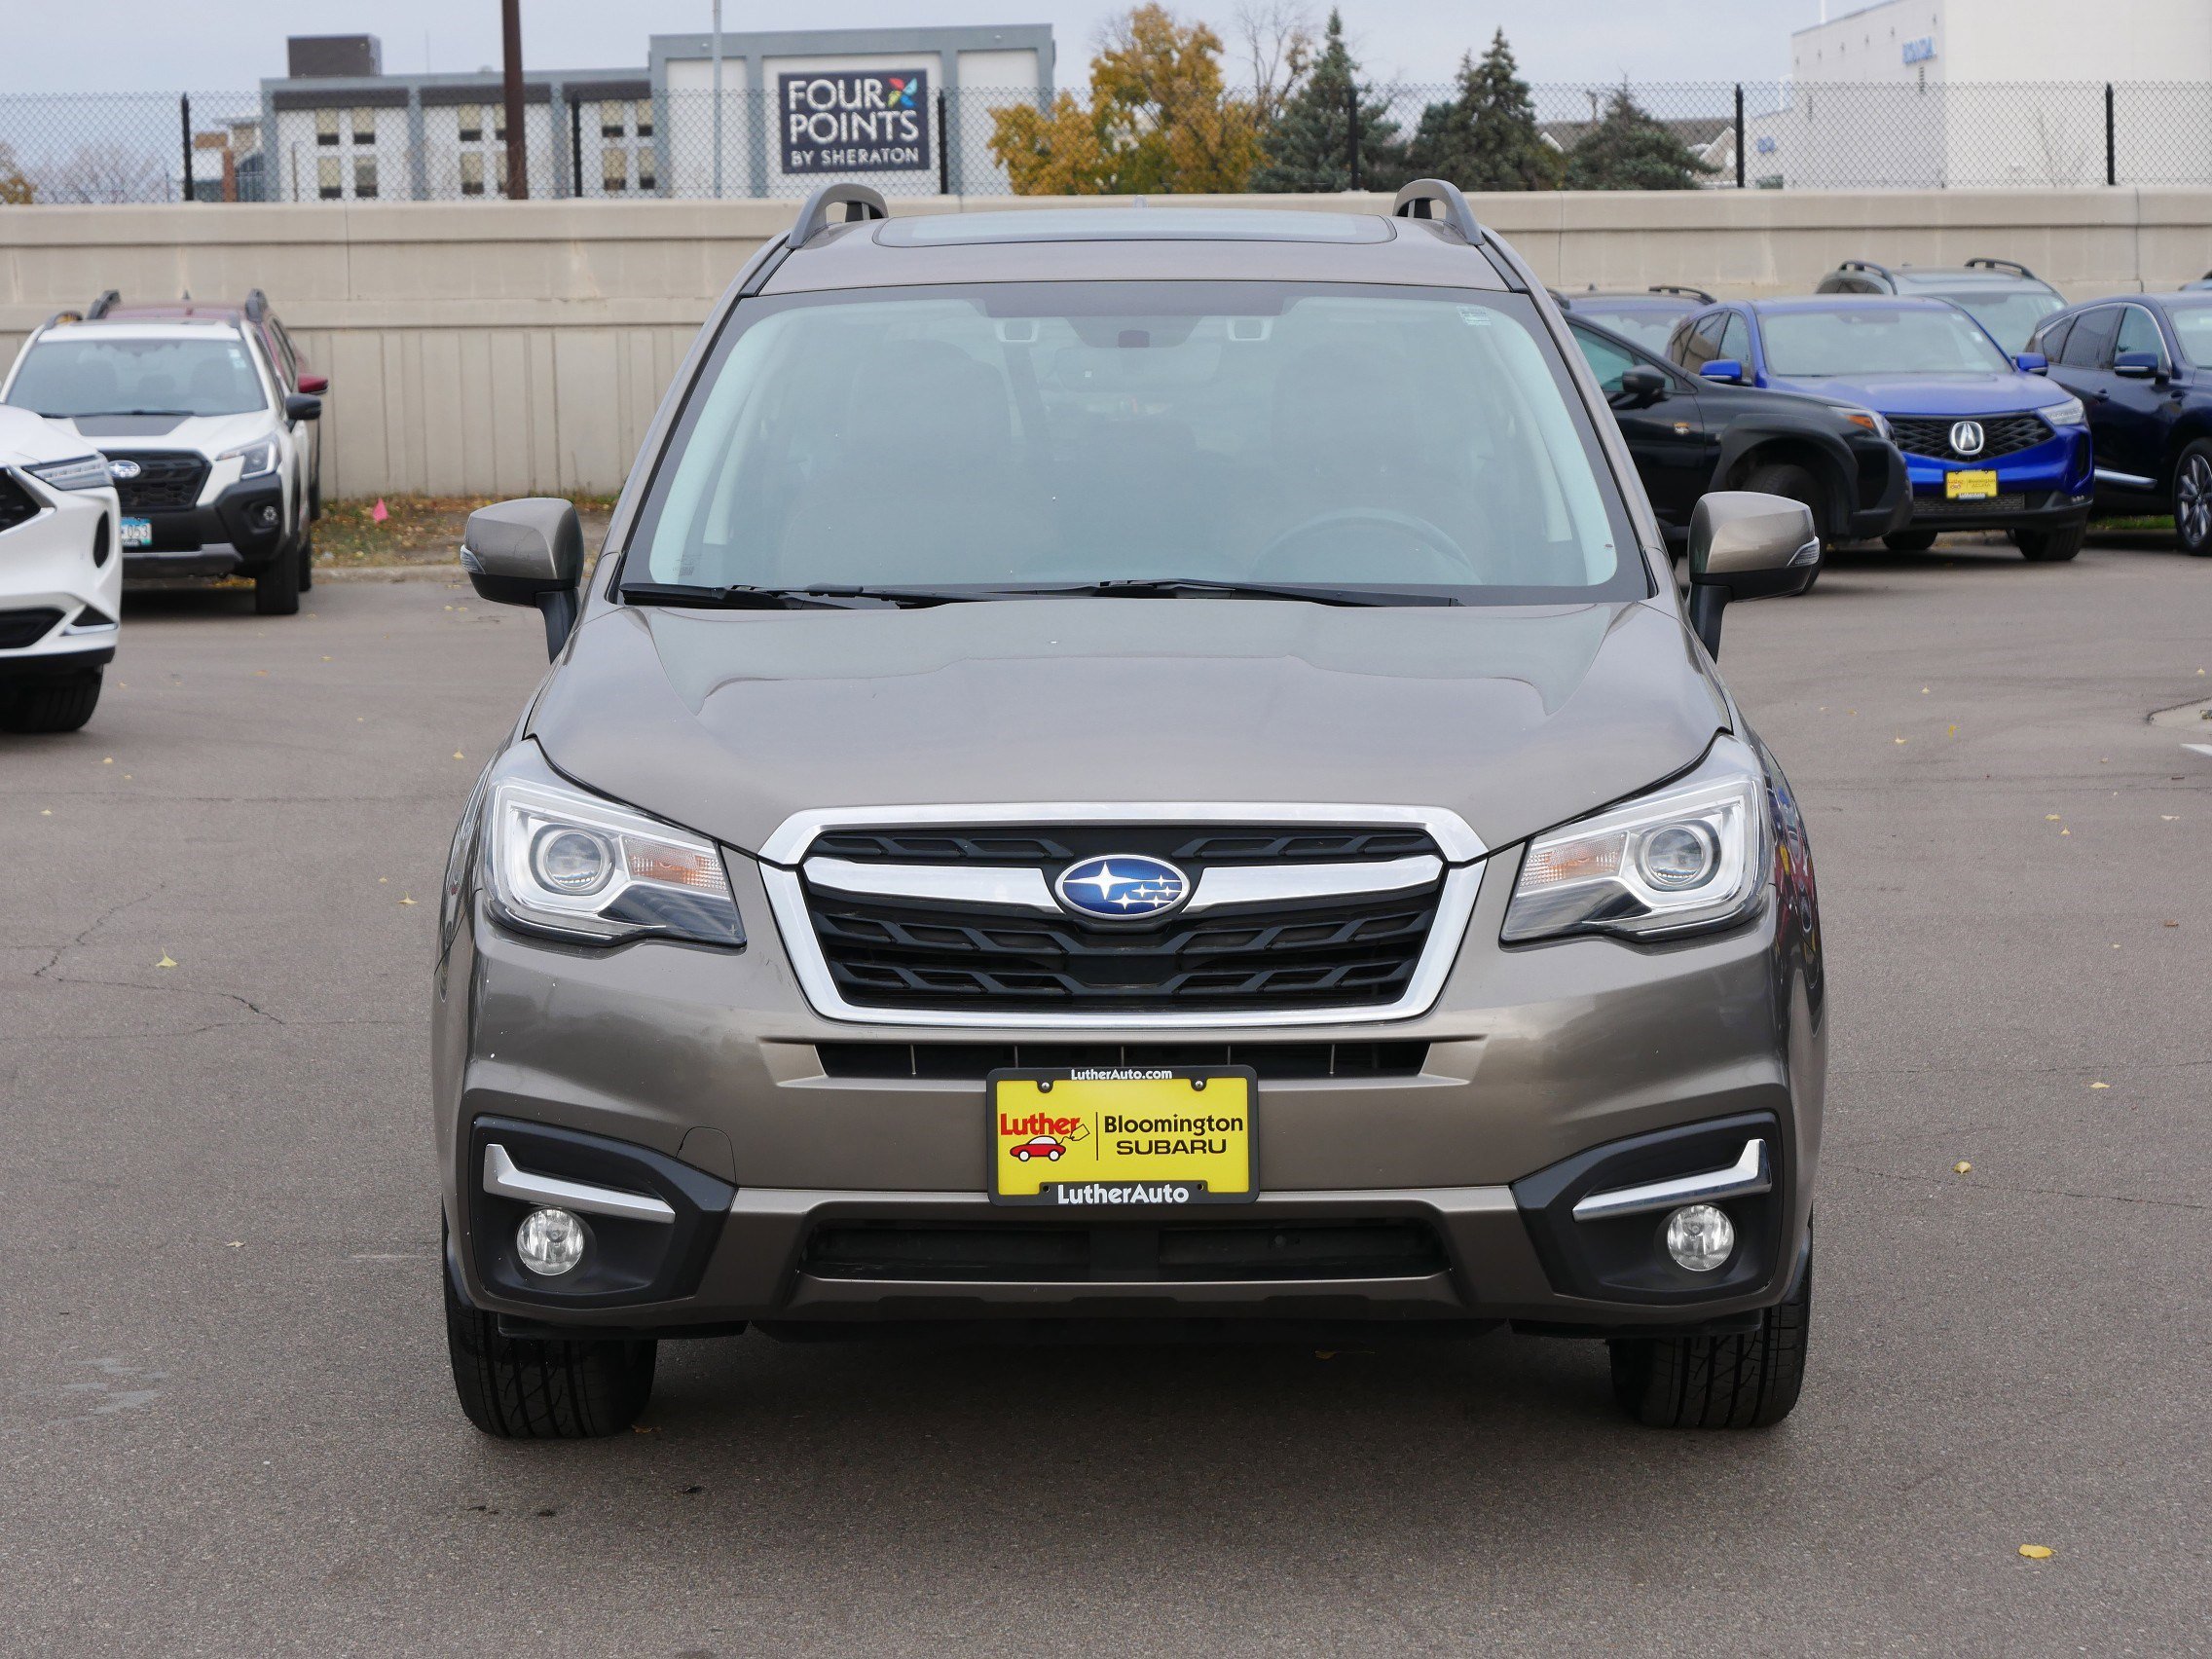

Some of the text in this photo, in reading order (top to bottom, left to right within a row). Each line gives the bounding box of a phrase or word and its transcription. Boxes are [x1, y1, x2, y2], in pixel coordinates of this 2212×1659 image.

[788, 78, 886, 111] FOUR
[790, 109, 919, 144] POINTS
[791, 147, 919, 167] BY SHERATON
[1071, 1068, 1172, 1081] LutherAuto.com
[1000, 1113, 1081, 1136] Luther
[1104, 1114, 1243, 1136] Bloomington
[1116, 1139, 1227, 1156] SUBARU
[1057, 1184, 1189, 1204] LutherAuto
